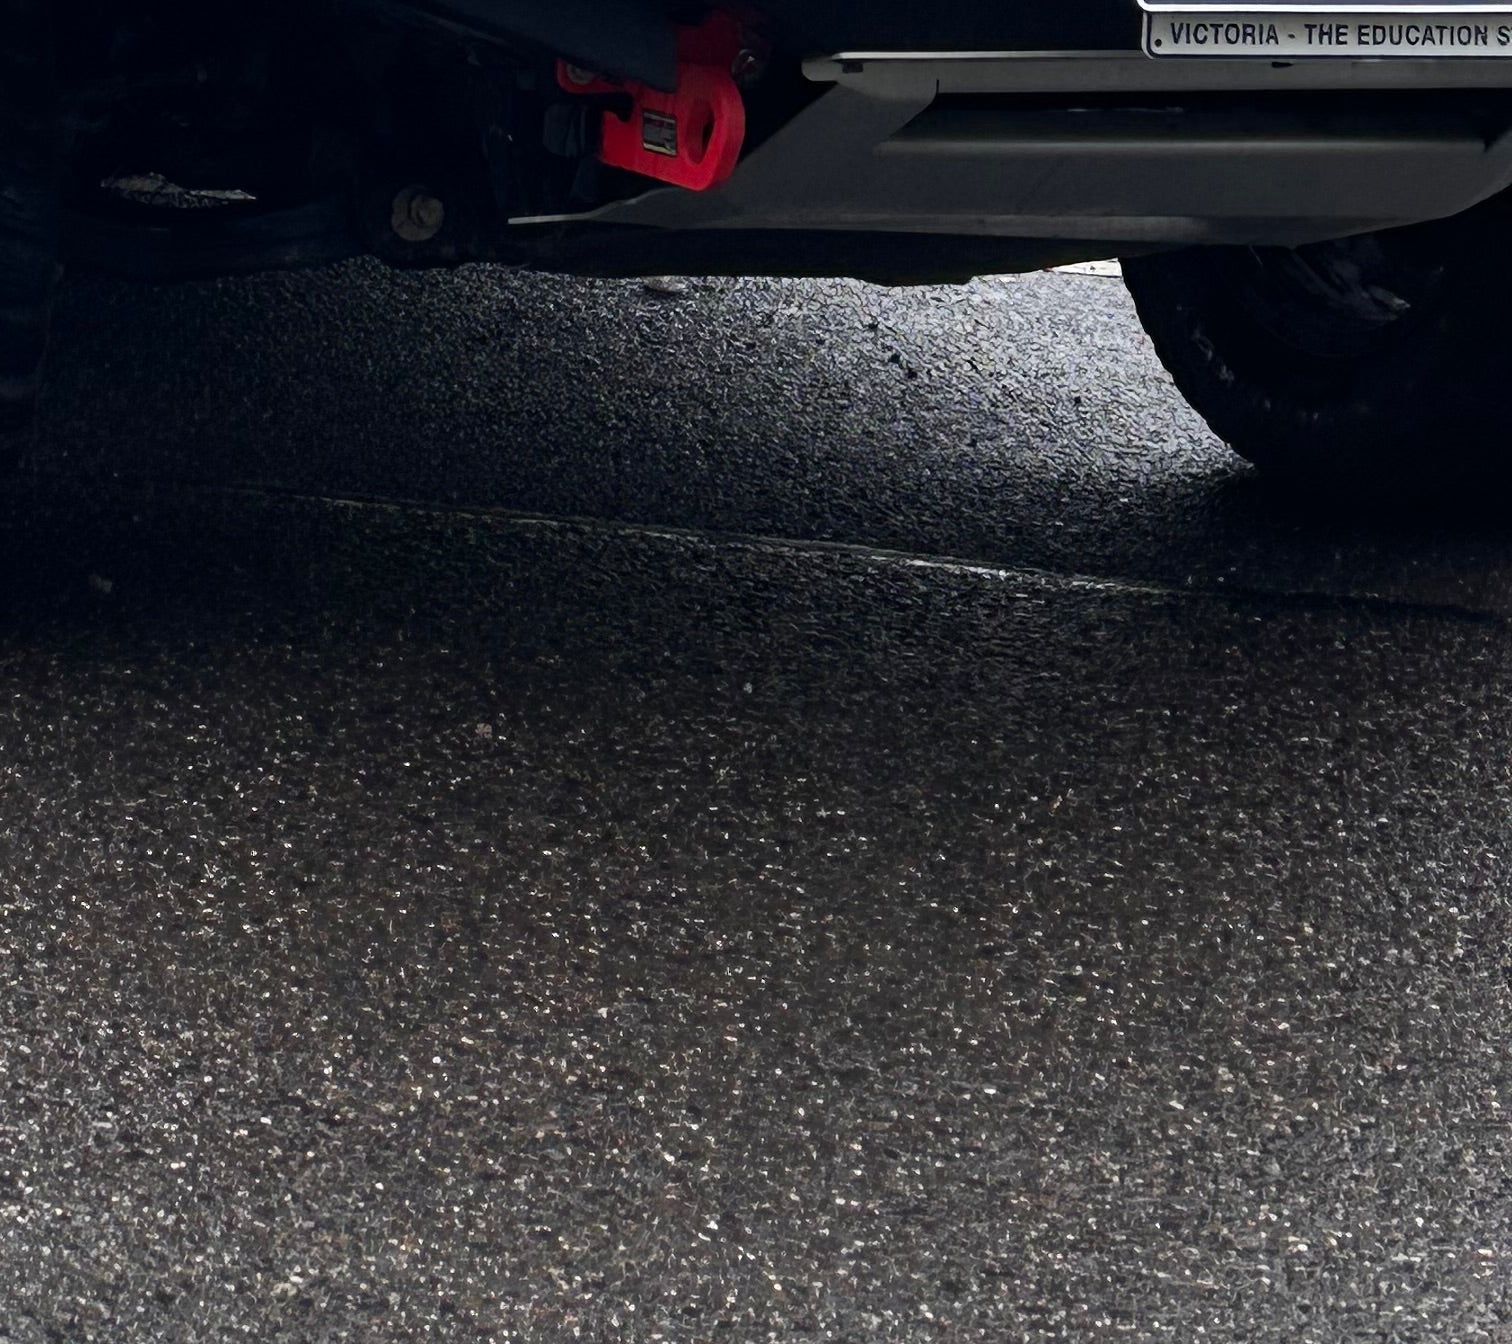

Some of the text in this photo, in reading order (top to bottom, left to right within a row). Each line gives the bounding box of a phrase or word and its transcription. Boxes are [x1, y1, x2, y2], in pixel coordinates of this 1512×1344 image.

[1170, 21, 1279, 46] VICTORIA
[1304, 22, 1348, 46] THE
[1358, 23, 1488, 47] EDUCATION
[1497, 25, 1512, 46] S
